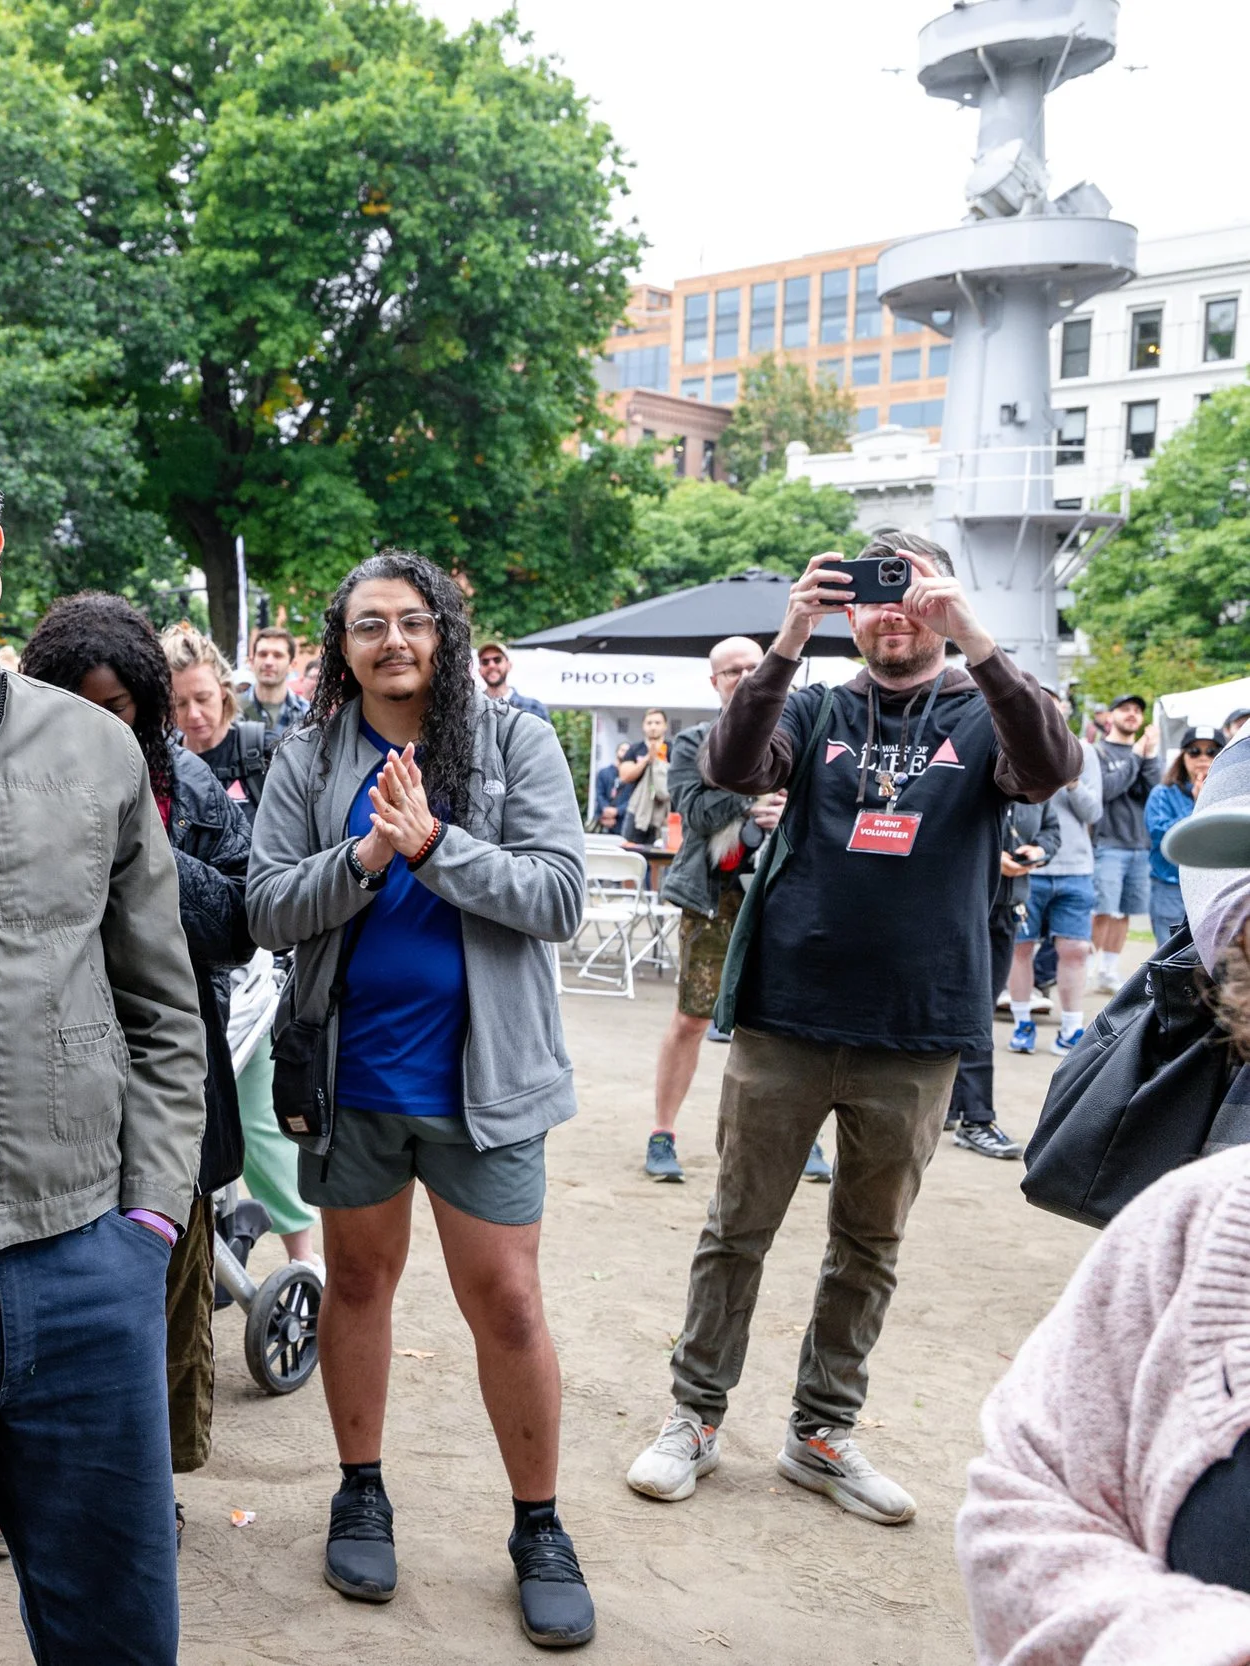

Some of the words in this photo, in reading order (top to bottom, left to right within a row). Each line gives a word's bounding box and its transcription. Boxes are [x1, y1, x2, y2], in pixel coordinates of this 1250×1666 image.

[561, 671, 655, 685] PHOTOS
[882, 744, 912, 753] WALS
[857, 751, 927, 776] LFE
[873, 819, 902, 829] EVENT
[860, 828, 909, 839] VOLUNTEER
